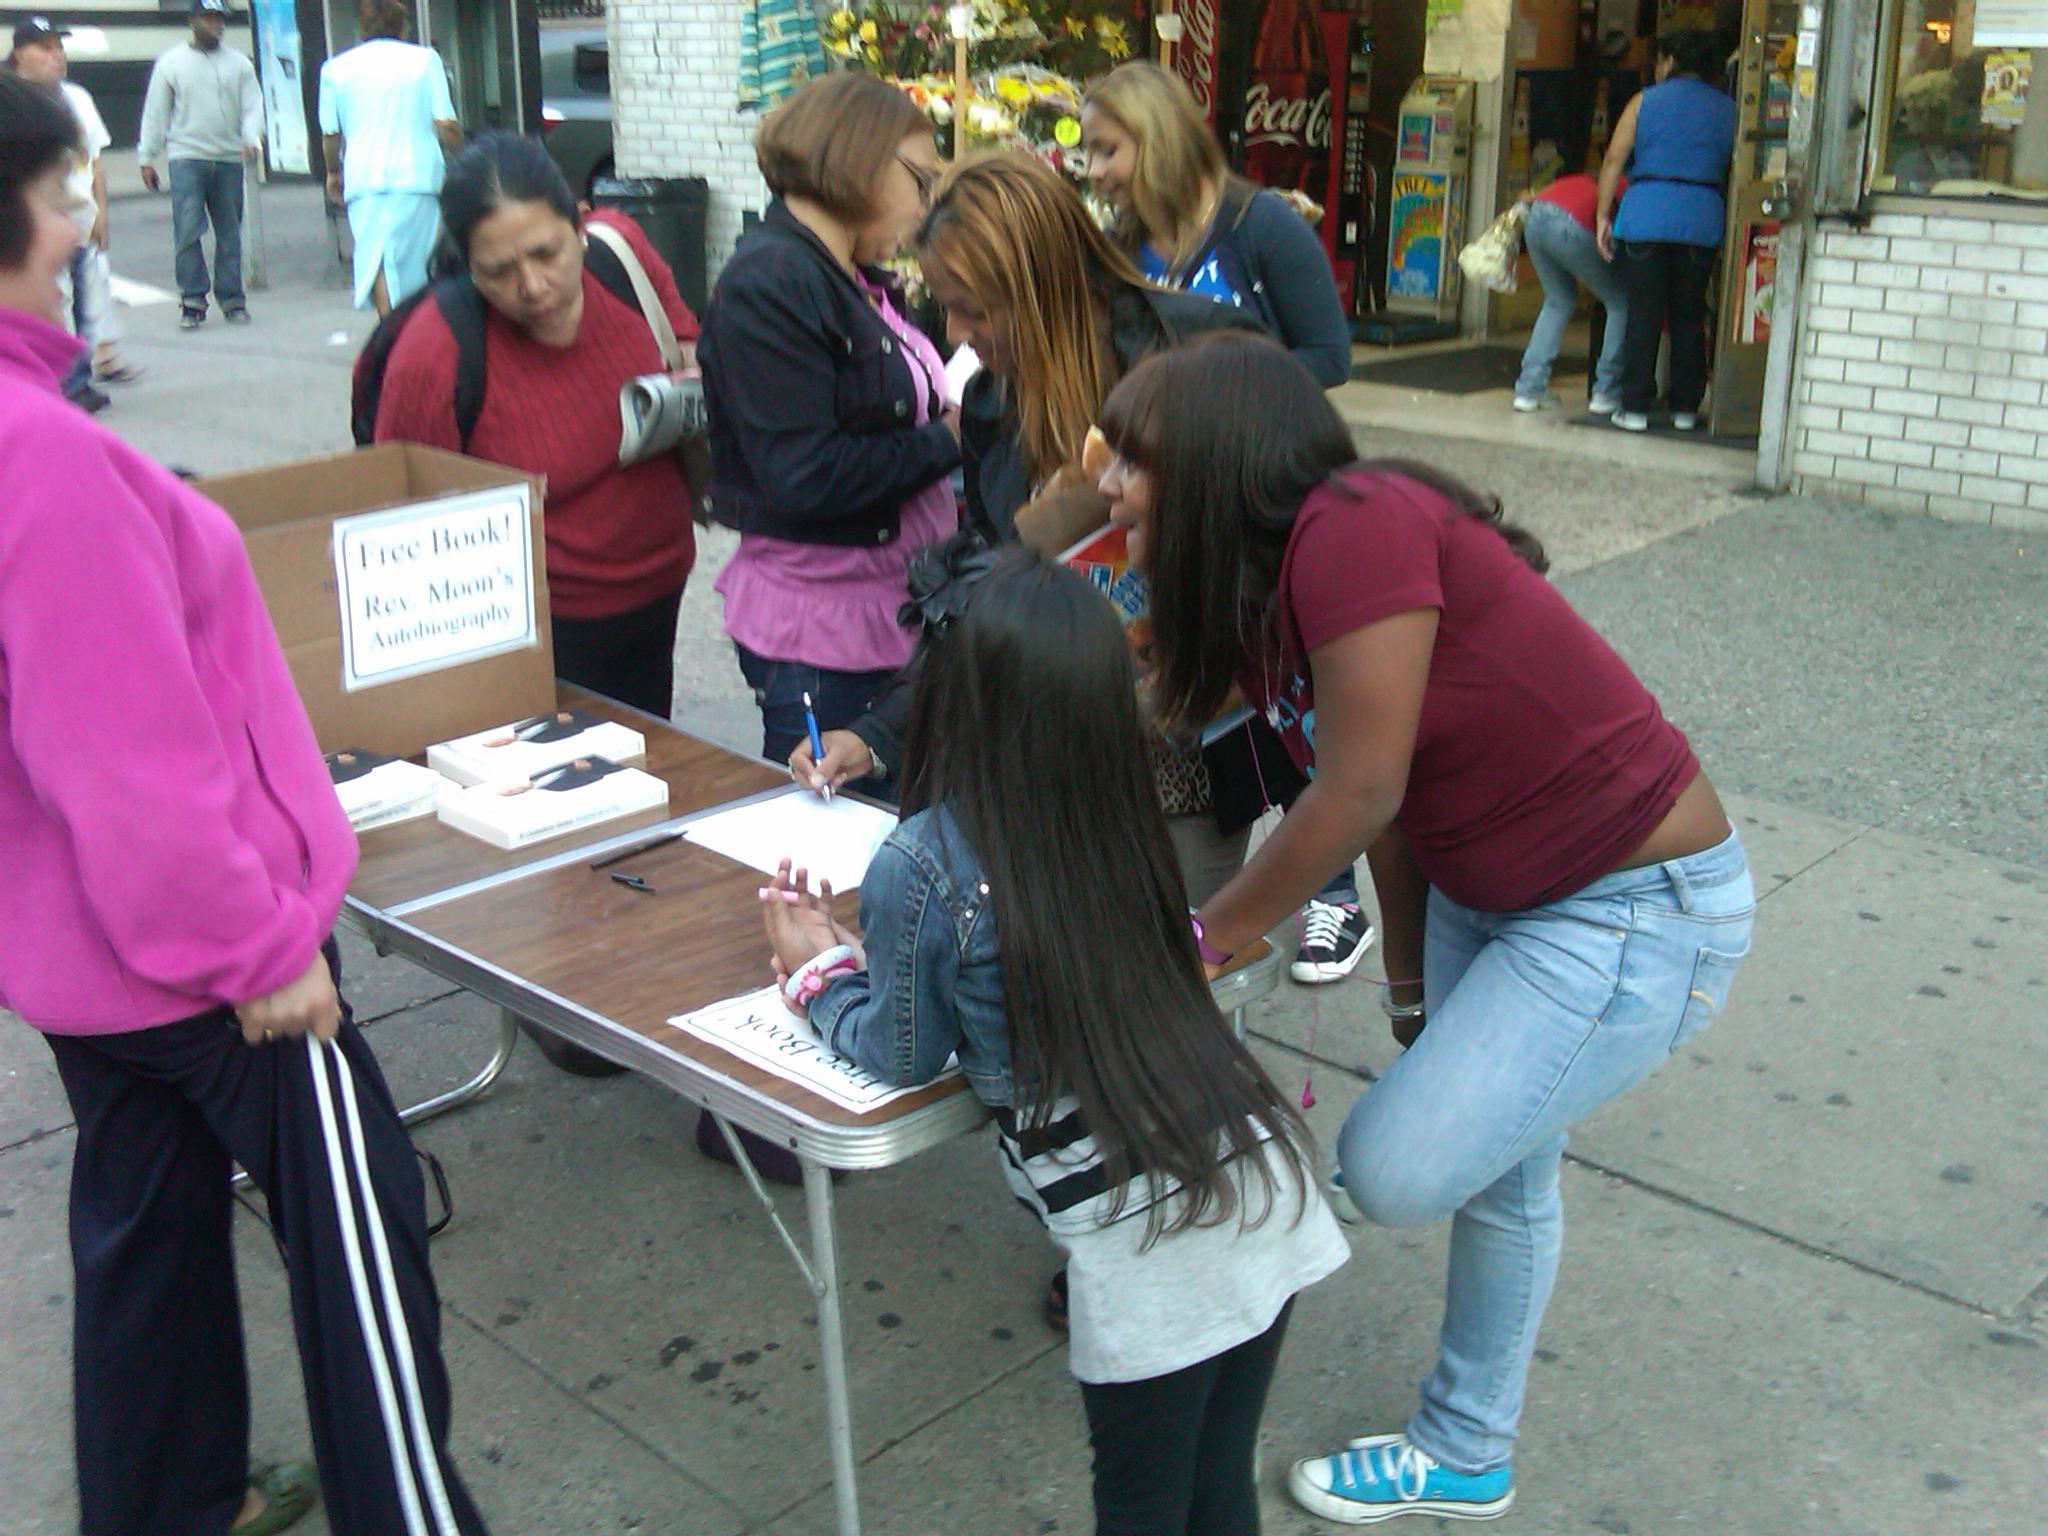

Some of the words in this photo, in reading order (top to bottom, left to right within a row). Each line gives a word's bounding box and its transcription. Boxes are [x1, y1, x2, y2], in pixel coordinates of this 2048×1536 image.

[360, 539, 421, 570] Free
[431, 513, 511, 556] Book!
[427, 566, 514, 605] Moon's
[369, 601, 513, 649] Autobiography
[735, 1013, 818, 1057] Book
